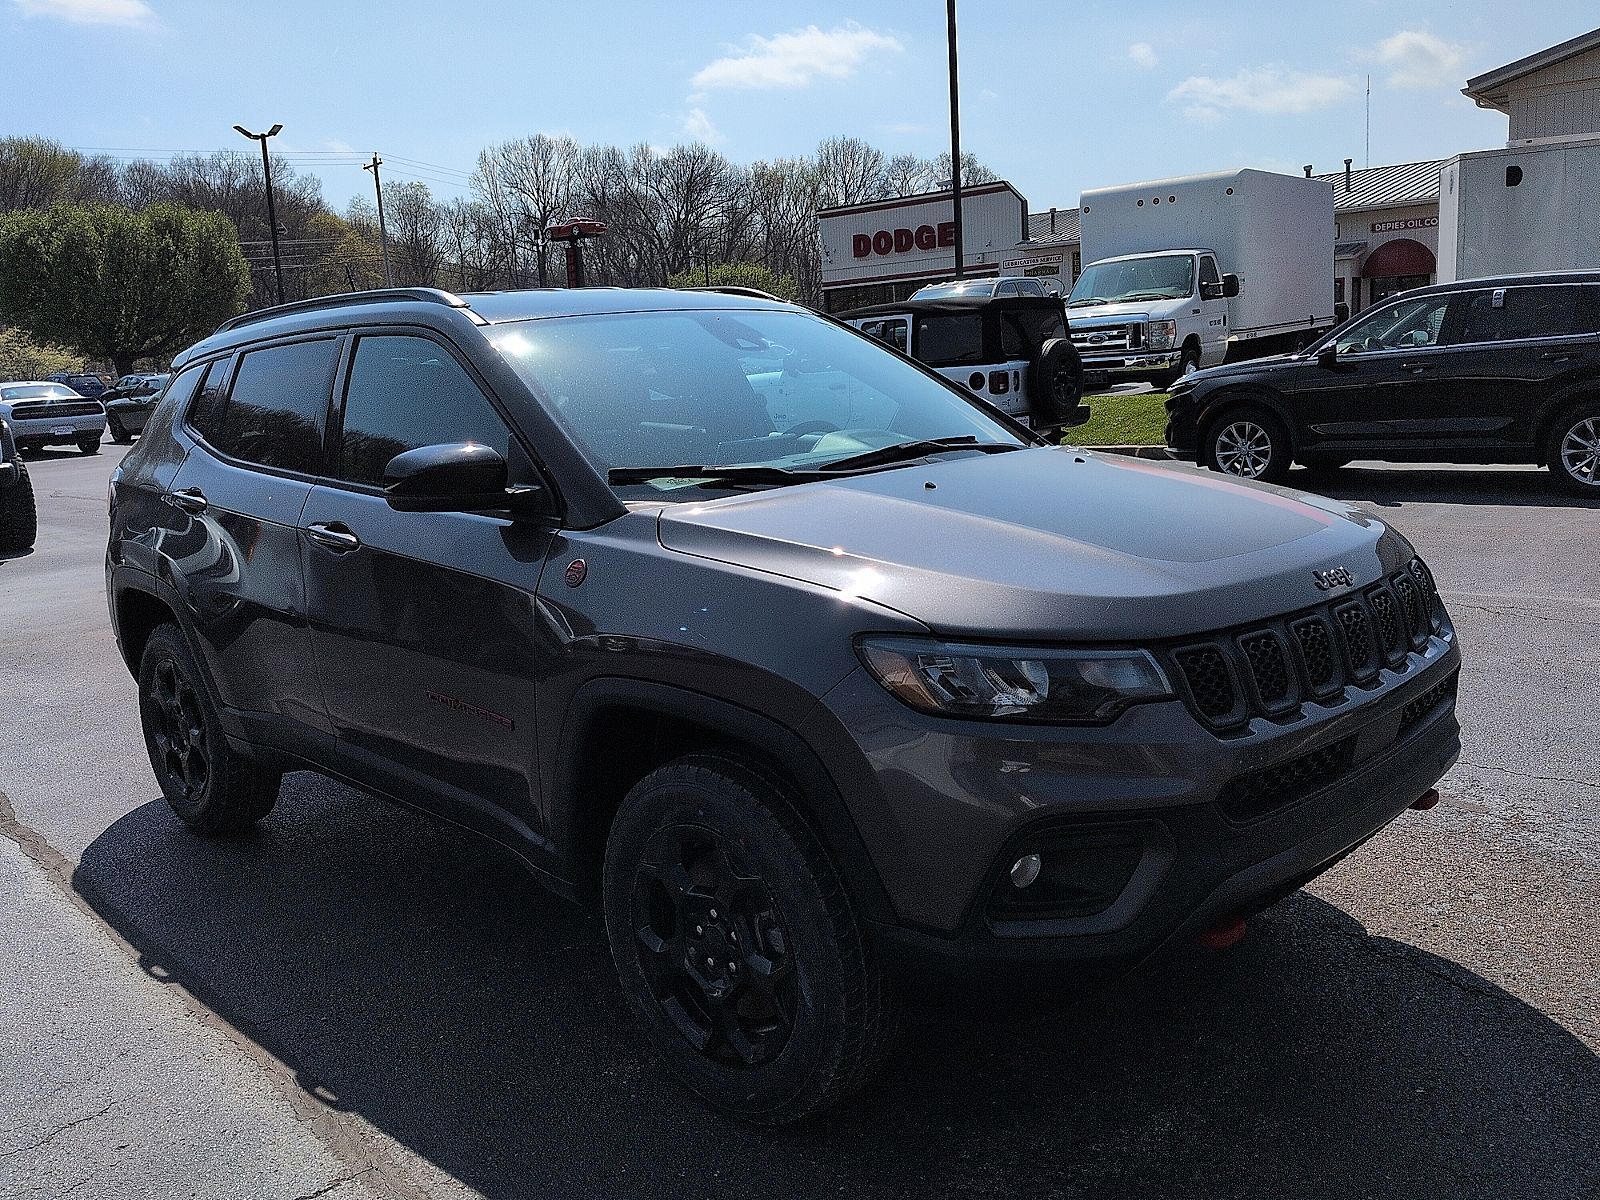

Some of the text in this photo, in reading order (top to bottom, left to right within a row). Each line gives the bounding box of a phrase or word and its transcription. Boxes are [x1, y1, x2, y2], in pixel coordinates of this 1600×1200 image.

[1375, 221, 1405, 231] DEPIES
[1407, 219, 1423, 228] OIL
[853, 221, 956, 258] DODGE
[1004, 255, 1062, 267] LUBRICATION SERVICE
[1025, 267, 1058, 276] PHARMACY
[1312, 567, 1353, 590] Jeep
